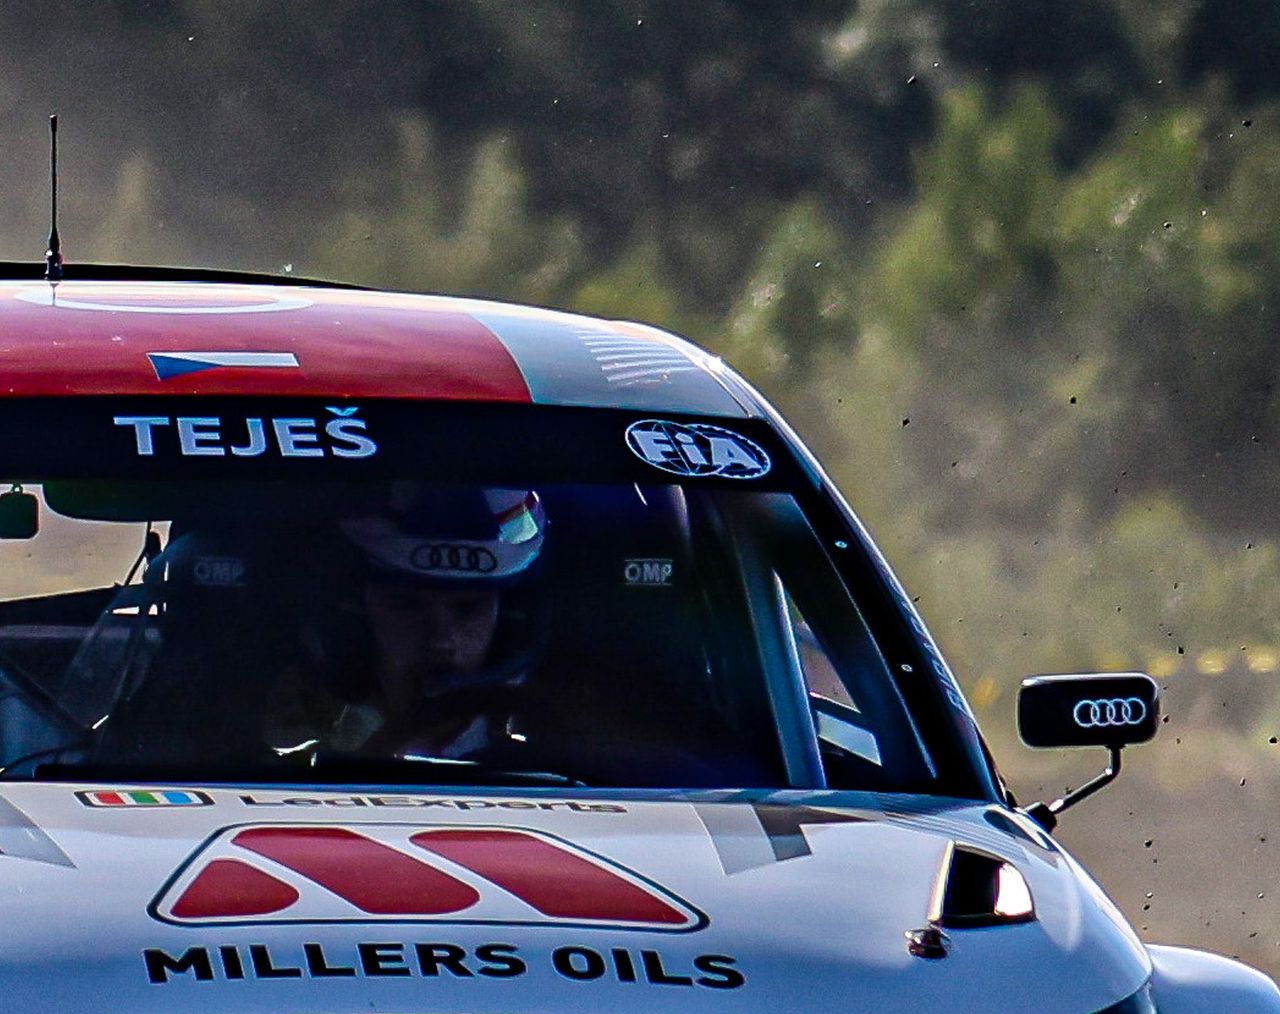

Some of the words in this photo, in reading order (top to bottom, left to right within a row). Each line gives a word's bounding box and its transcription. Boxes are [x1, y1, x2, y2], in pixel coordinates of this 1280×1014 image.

[113, 405, 378, 459] TEJEŠ
[624, 562, 673, 582] OMP
[239, 795, 628, 815] LedExperts
[143, 943, 527, 985] MILLERS
[552, 947, 746, 990] OILS
